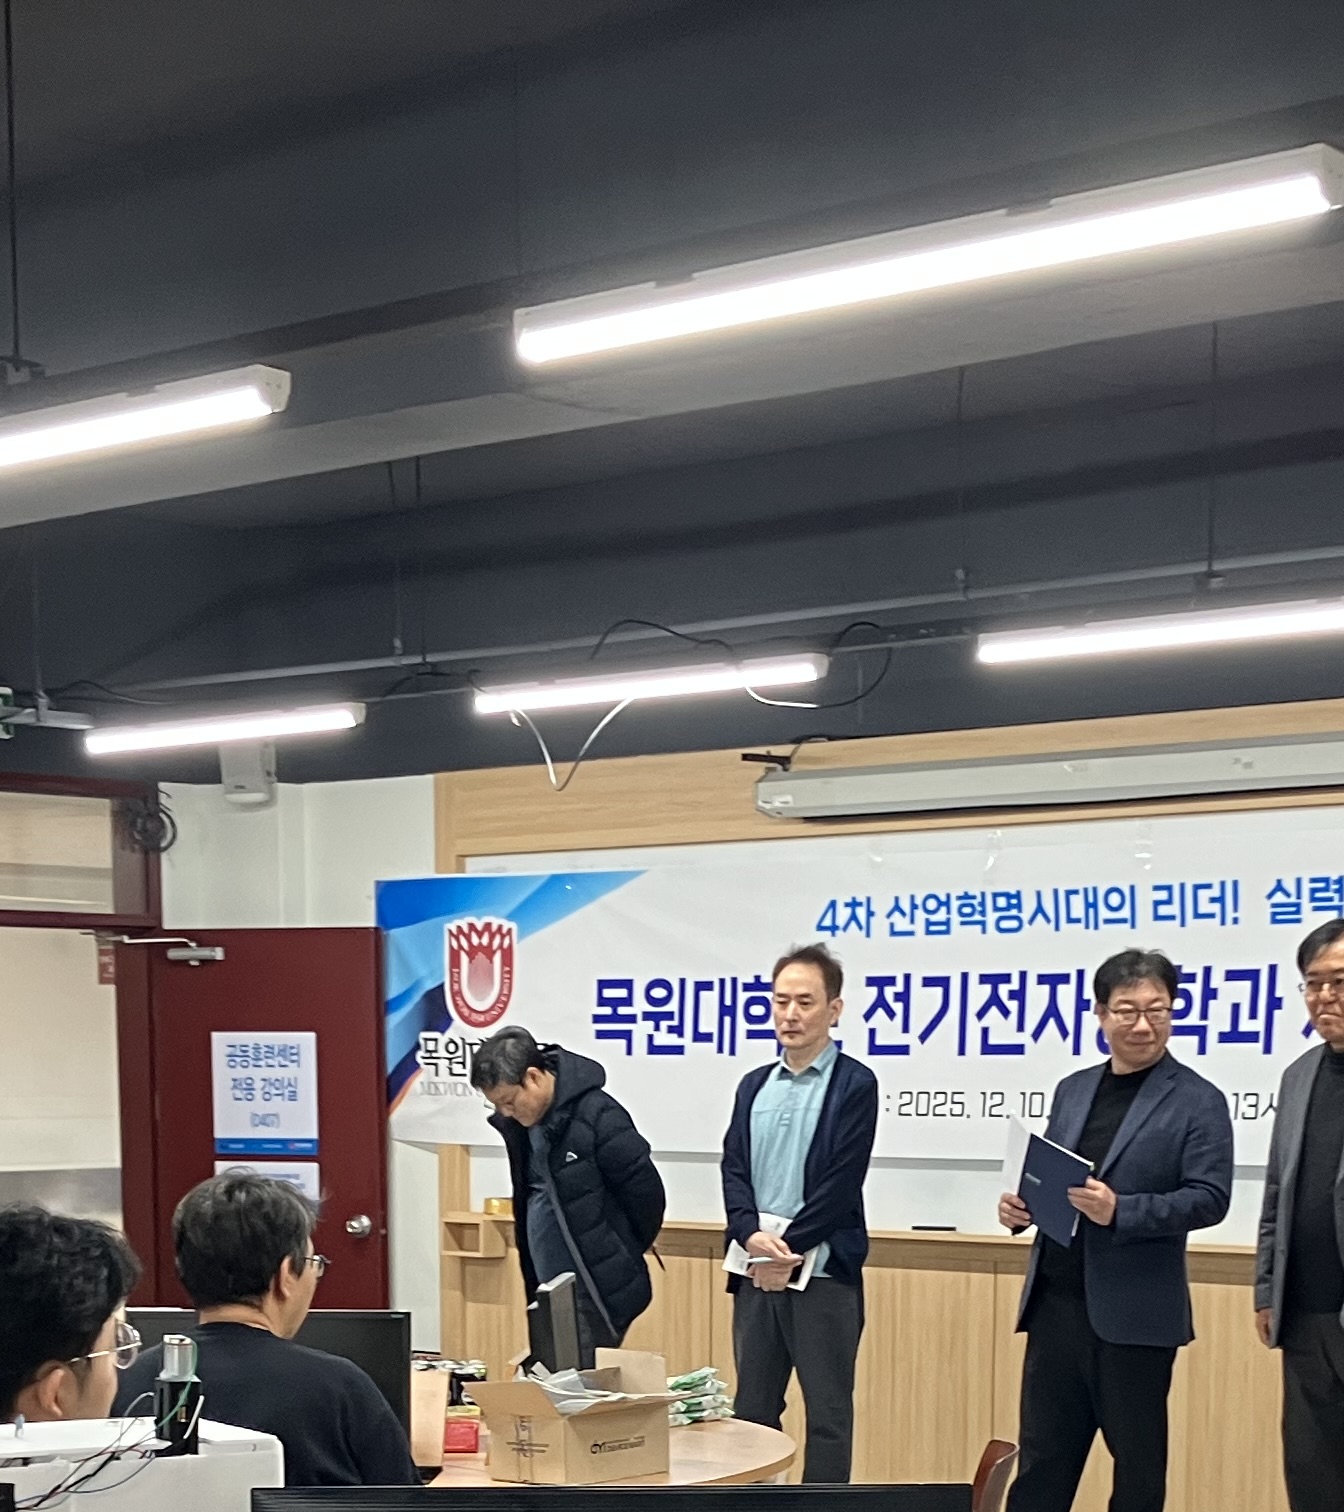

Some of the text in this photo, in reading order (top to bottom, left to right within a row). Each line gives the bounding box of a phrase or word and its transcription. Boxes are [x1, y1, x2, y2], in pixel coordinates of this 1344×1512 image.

[816, 896, 875, 938] 4차
[886, 884, 1136, 938] 산업혁명시대의
[1152, 879, 1239, 927] 리더!
[591, 975, 842, 1057] 목원대학
[863, 963, 1284, 1056] 전기전자학과
[225, 1043, 301, 1069] 공동훈련센터
[231, 1076, 299, 1102] 전용 강의실
[898, 1091, 970, 1119] 2025.
[980, 1091, 1011, 1120] 12.
